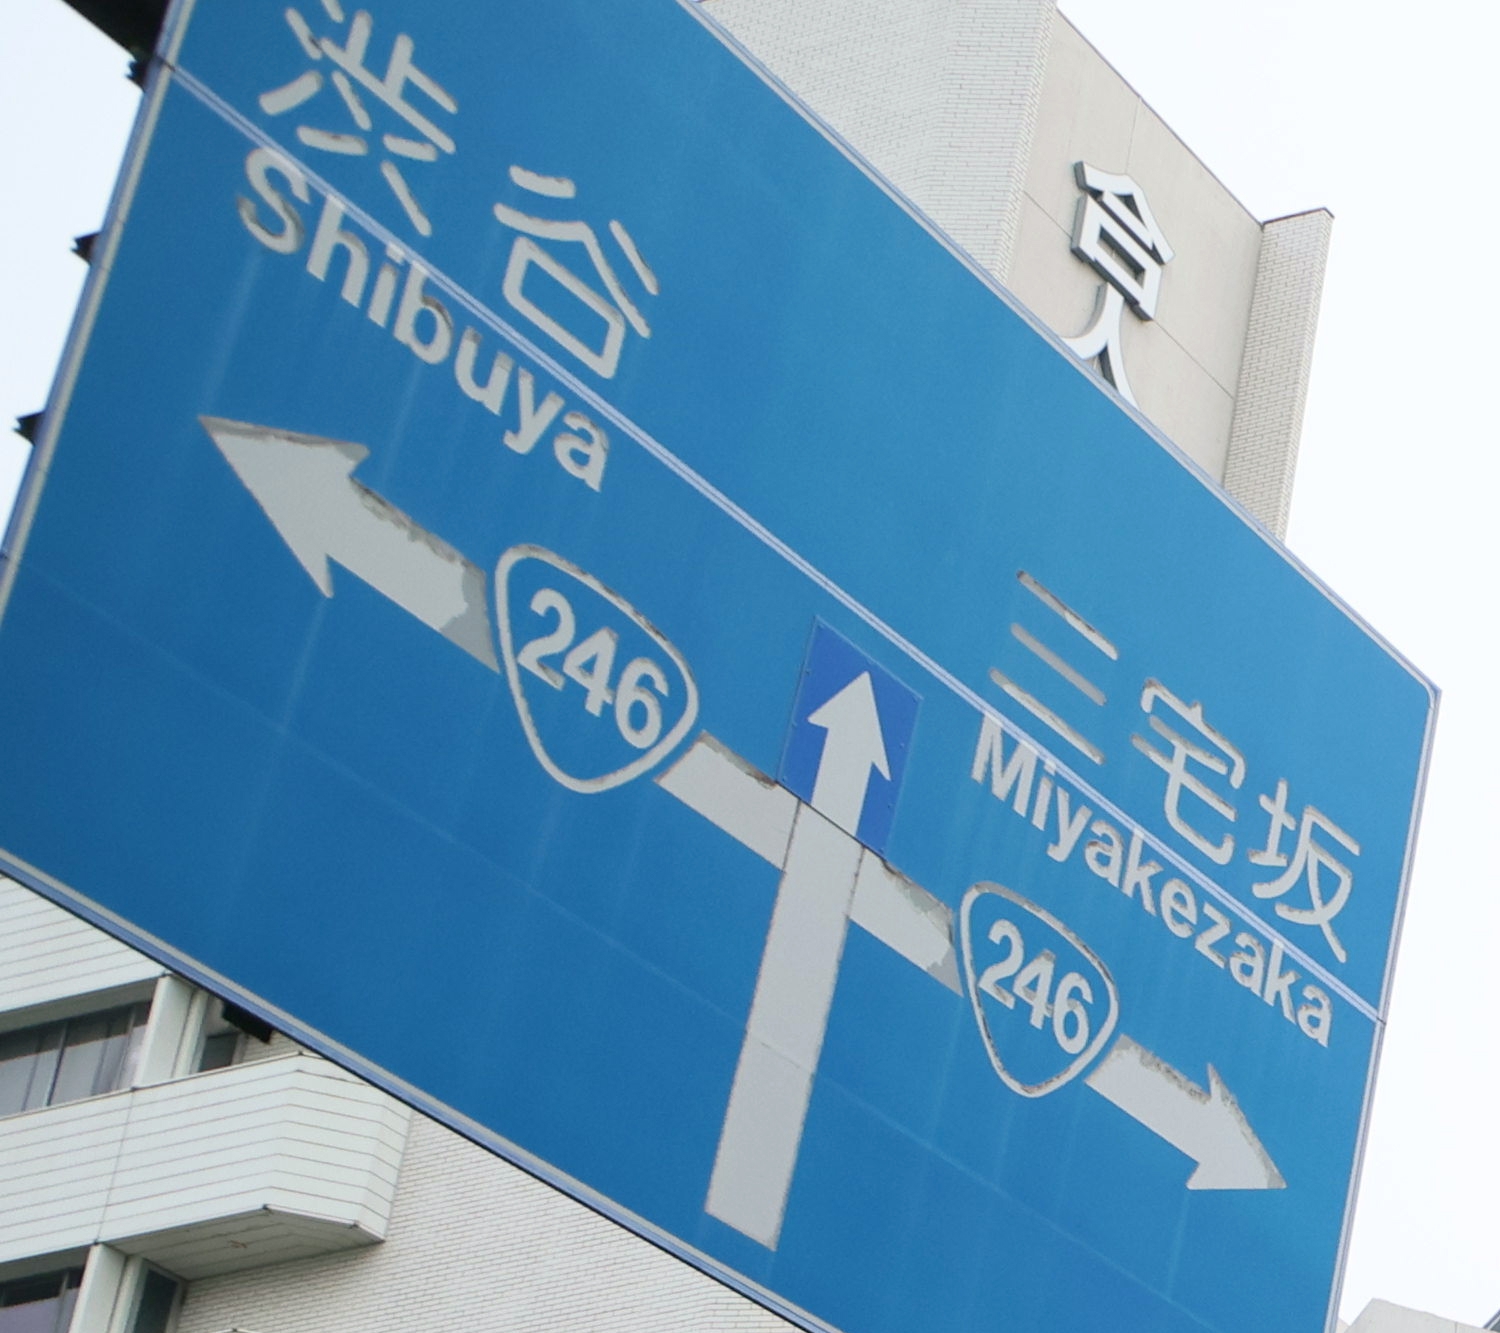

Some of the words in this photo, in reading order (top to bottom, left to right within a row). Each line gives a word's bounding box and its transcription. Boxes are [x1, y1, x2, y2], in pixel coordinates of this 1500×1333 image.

[237, 147, 609, 492] Shibuya
[258, 0, 657, 380] 渋谷
[515, 586, 664, 751] 246
[988, 569, 1361, 964] 三宅坂
[970, 709, 1334, 1048] Miyakezaka
[978, 917, 1094, 1055] 246
